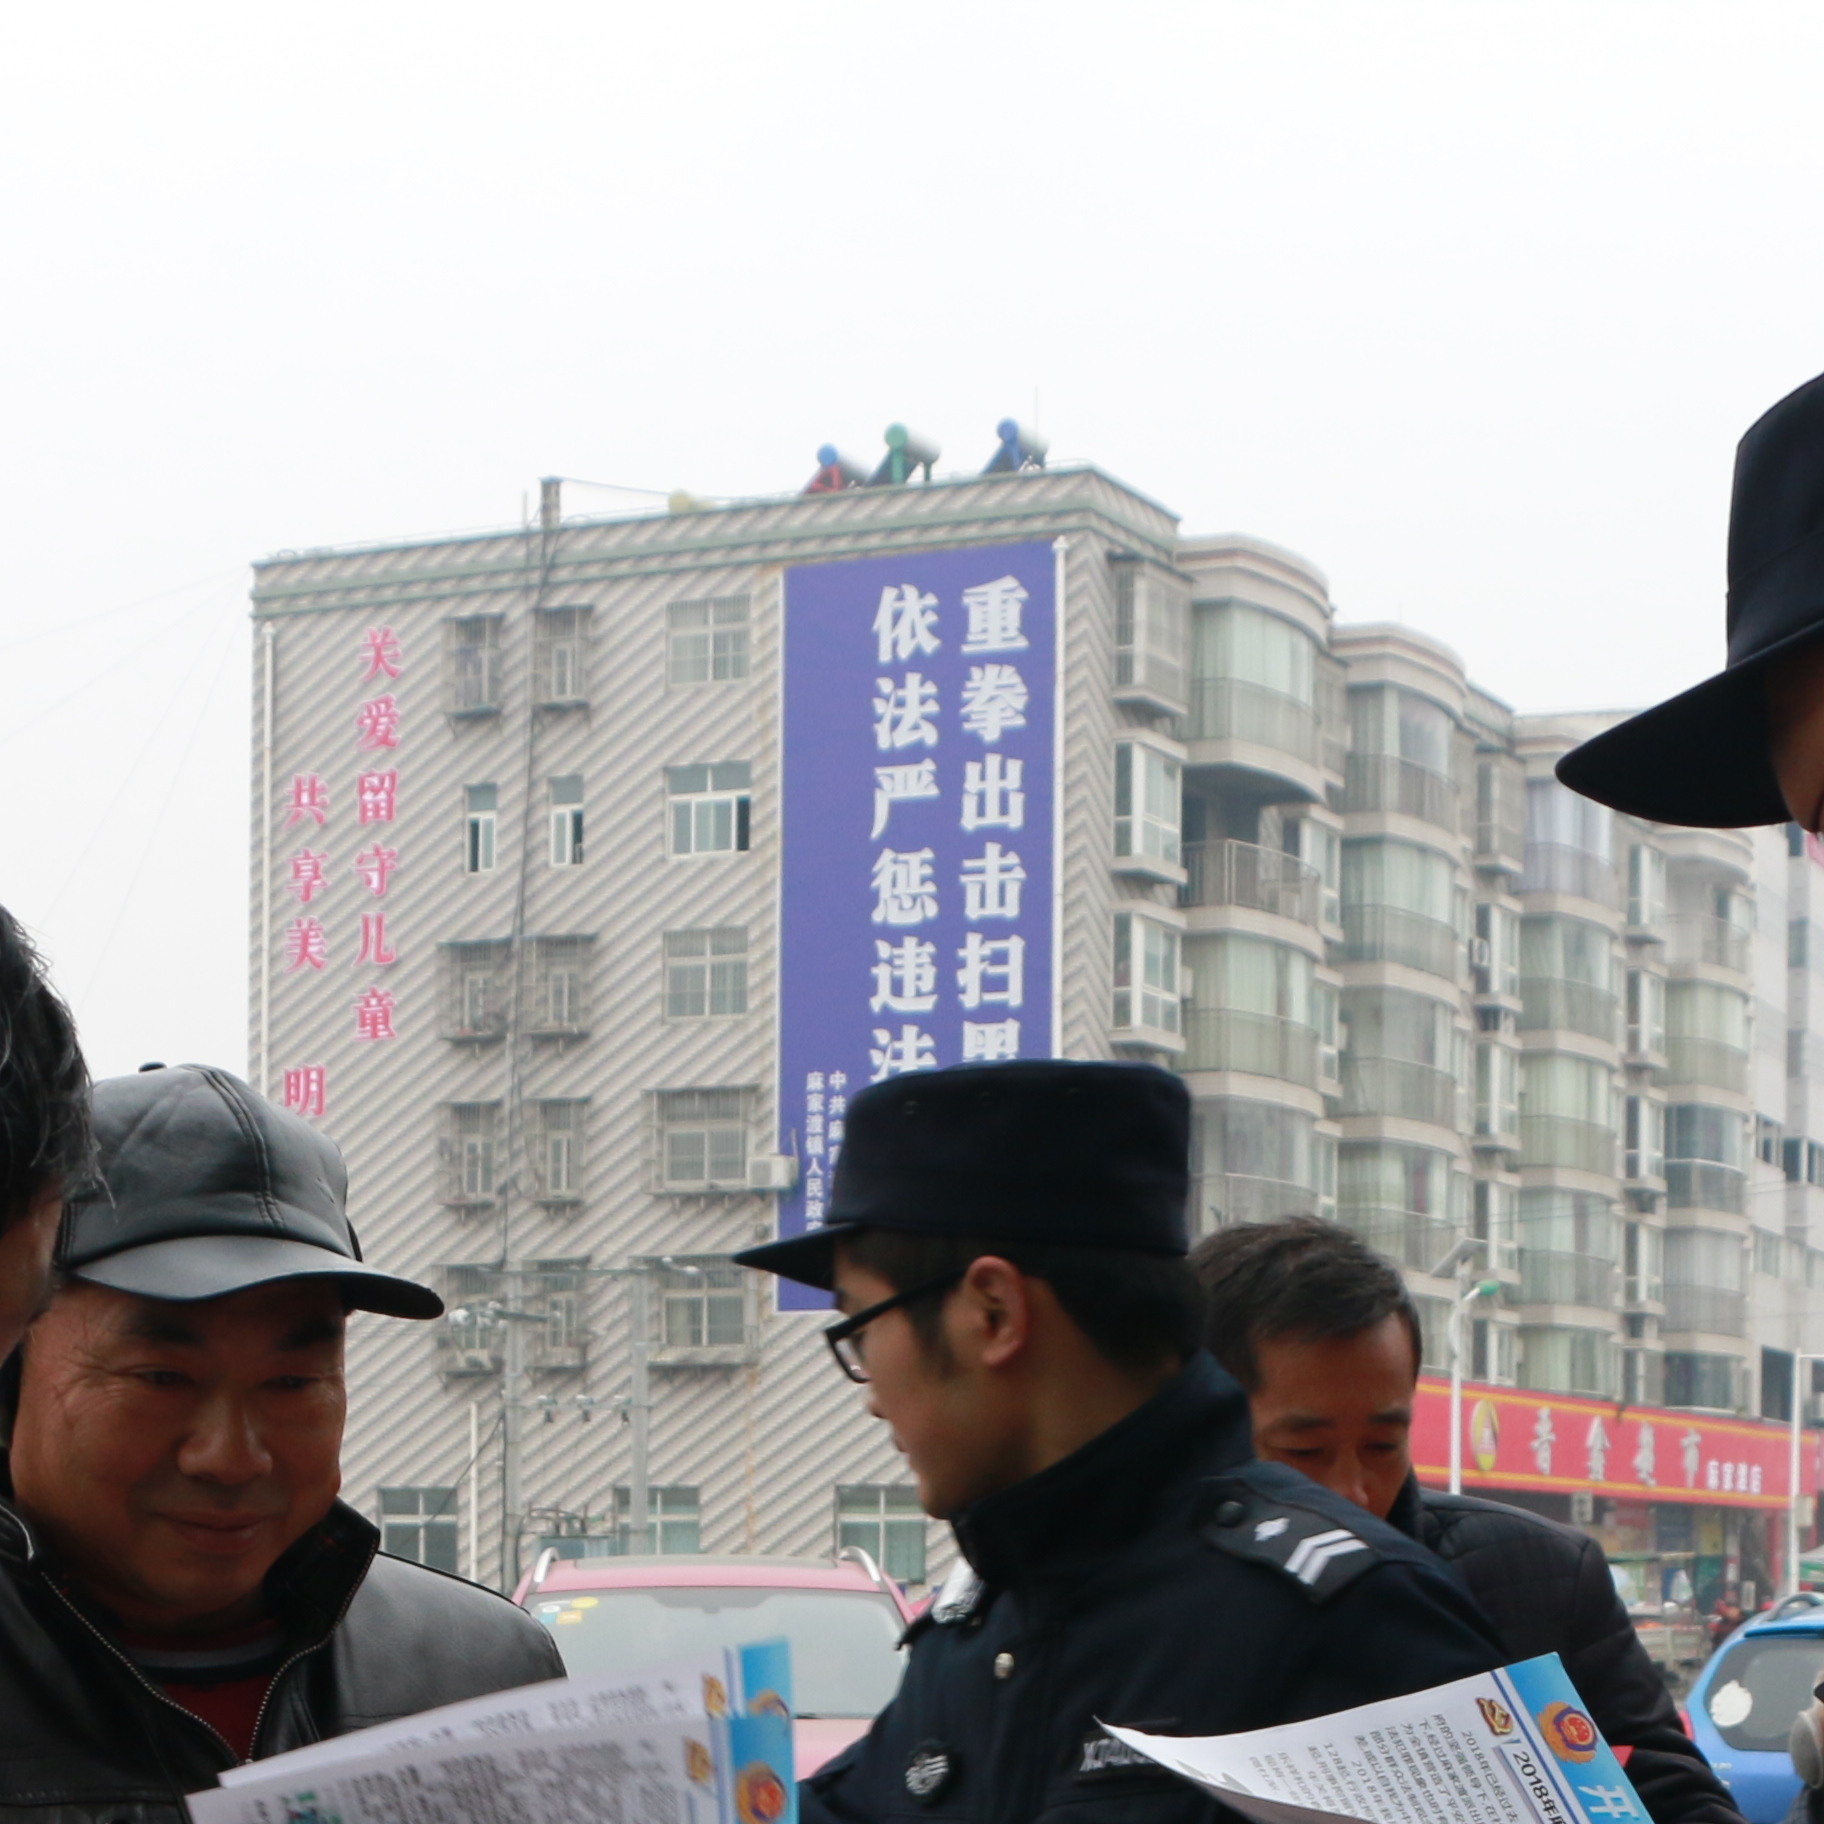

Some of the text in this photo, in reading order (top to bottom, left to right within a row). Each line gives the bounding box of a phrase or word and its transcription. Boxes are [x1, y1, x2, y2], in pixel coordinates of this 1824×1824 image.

[353, 626, 403, 1045] 关爱留守儿童
[828, 1070, 847, 1188] 中共麻家
